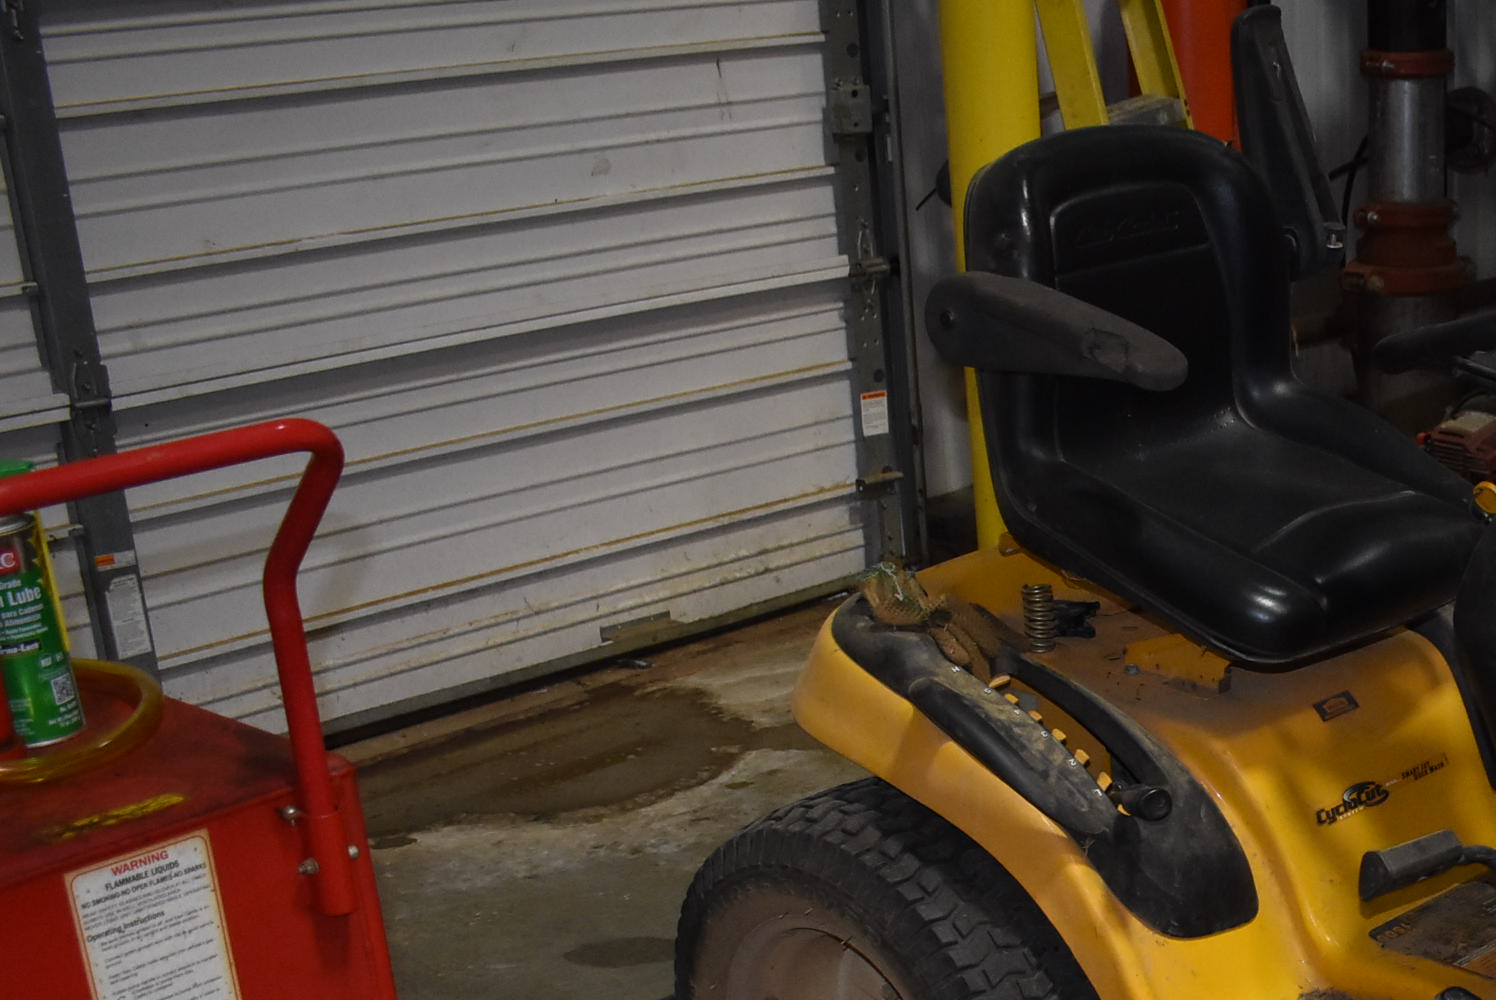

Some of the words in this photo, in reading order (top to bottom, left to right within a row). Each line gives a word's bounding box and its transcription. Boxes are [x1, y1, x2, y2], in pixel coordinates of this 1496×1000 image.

[6, 586, 42, 606] Lube
[104, 869, 149, 892] FLAMMABLE
[150, 859, 179, 875] LIQUIDS
[110, 849, 168, 877] WARNING
[85, 923, 124, 945] Operating
[123, 909, 165, 929] Instructions
